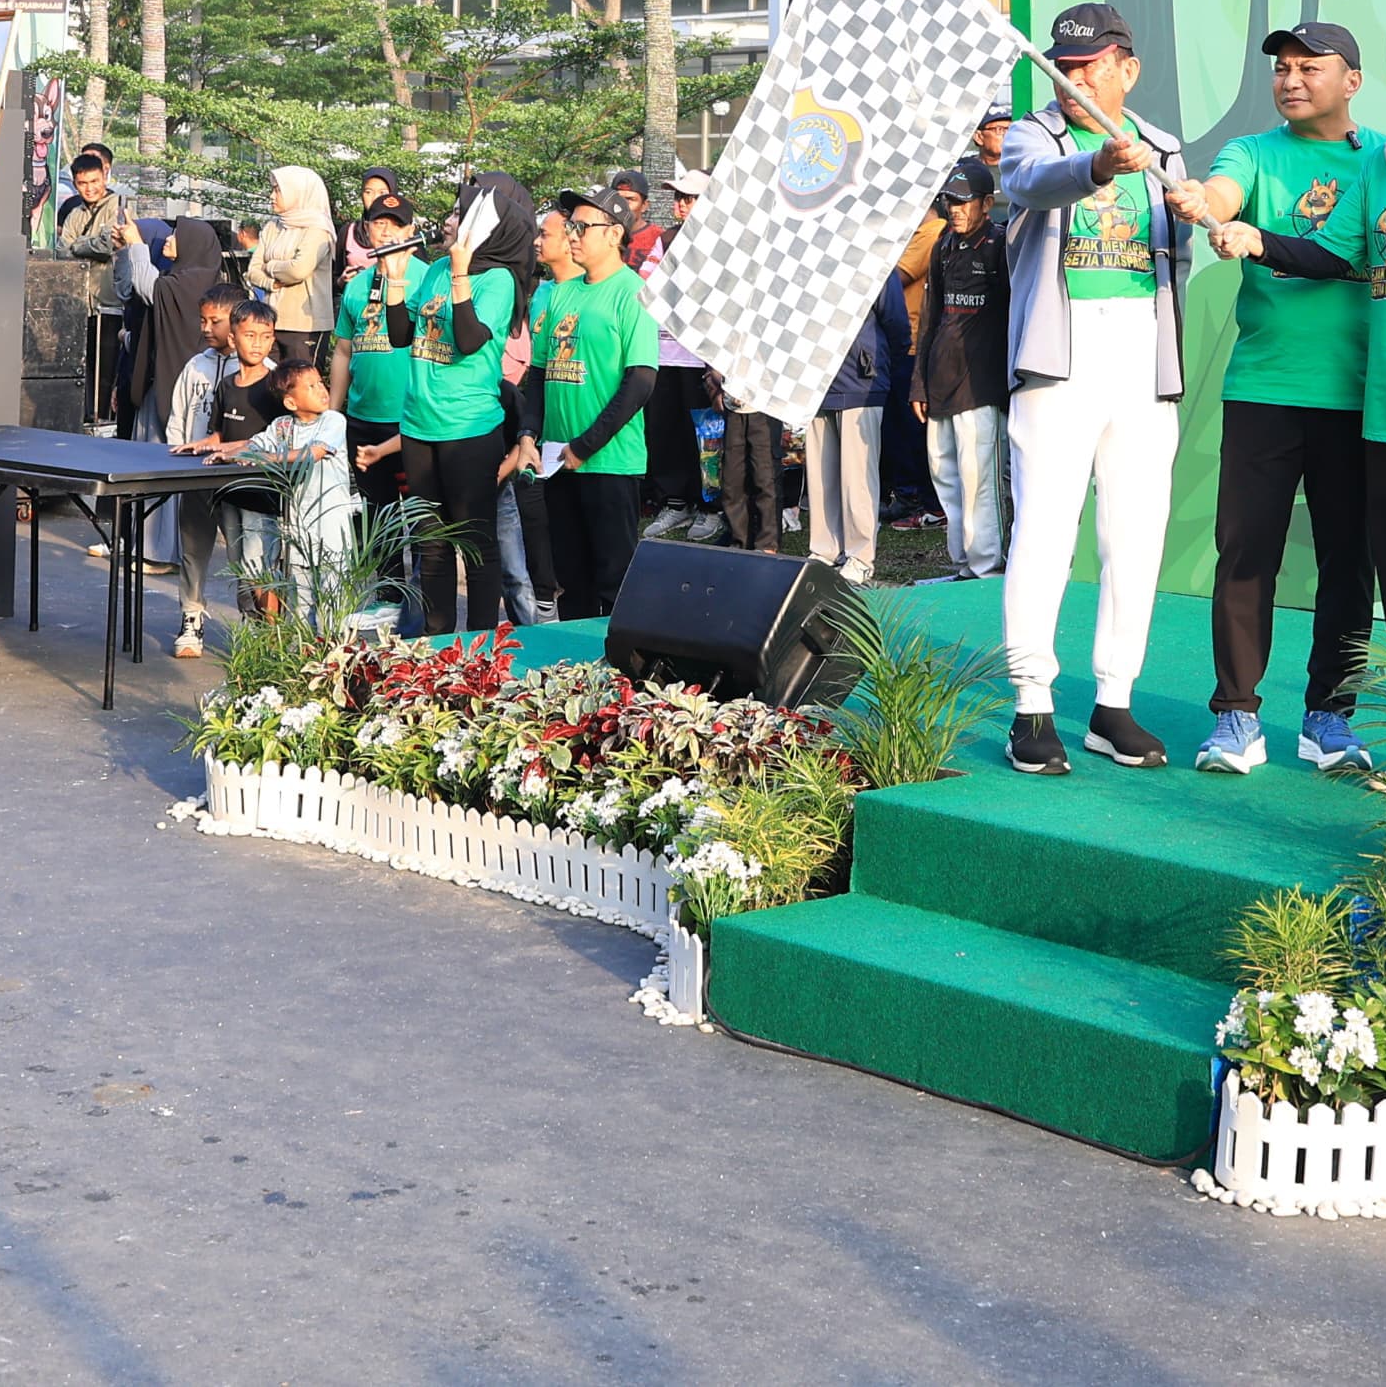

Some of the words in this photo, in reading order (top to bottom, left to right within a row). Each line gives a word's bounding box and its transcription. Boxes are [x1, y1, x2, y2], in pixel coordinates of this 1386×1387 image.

[1059, 19, 1095, 37] Riau
[1064, 253, 1099, 267] SETIA
[955, 294, 986, 306] SPORTS
